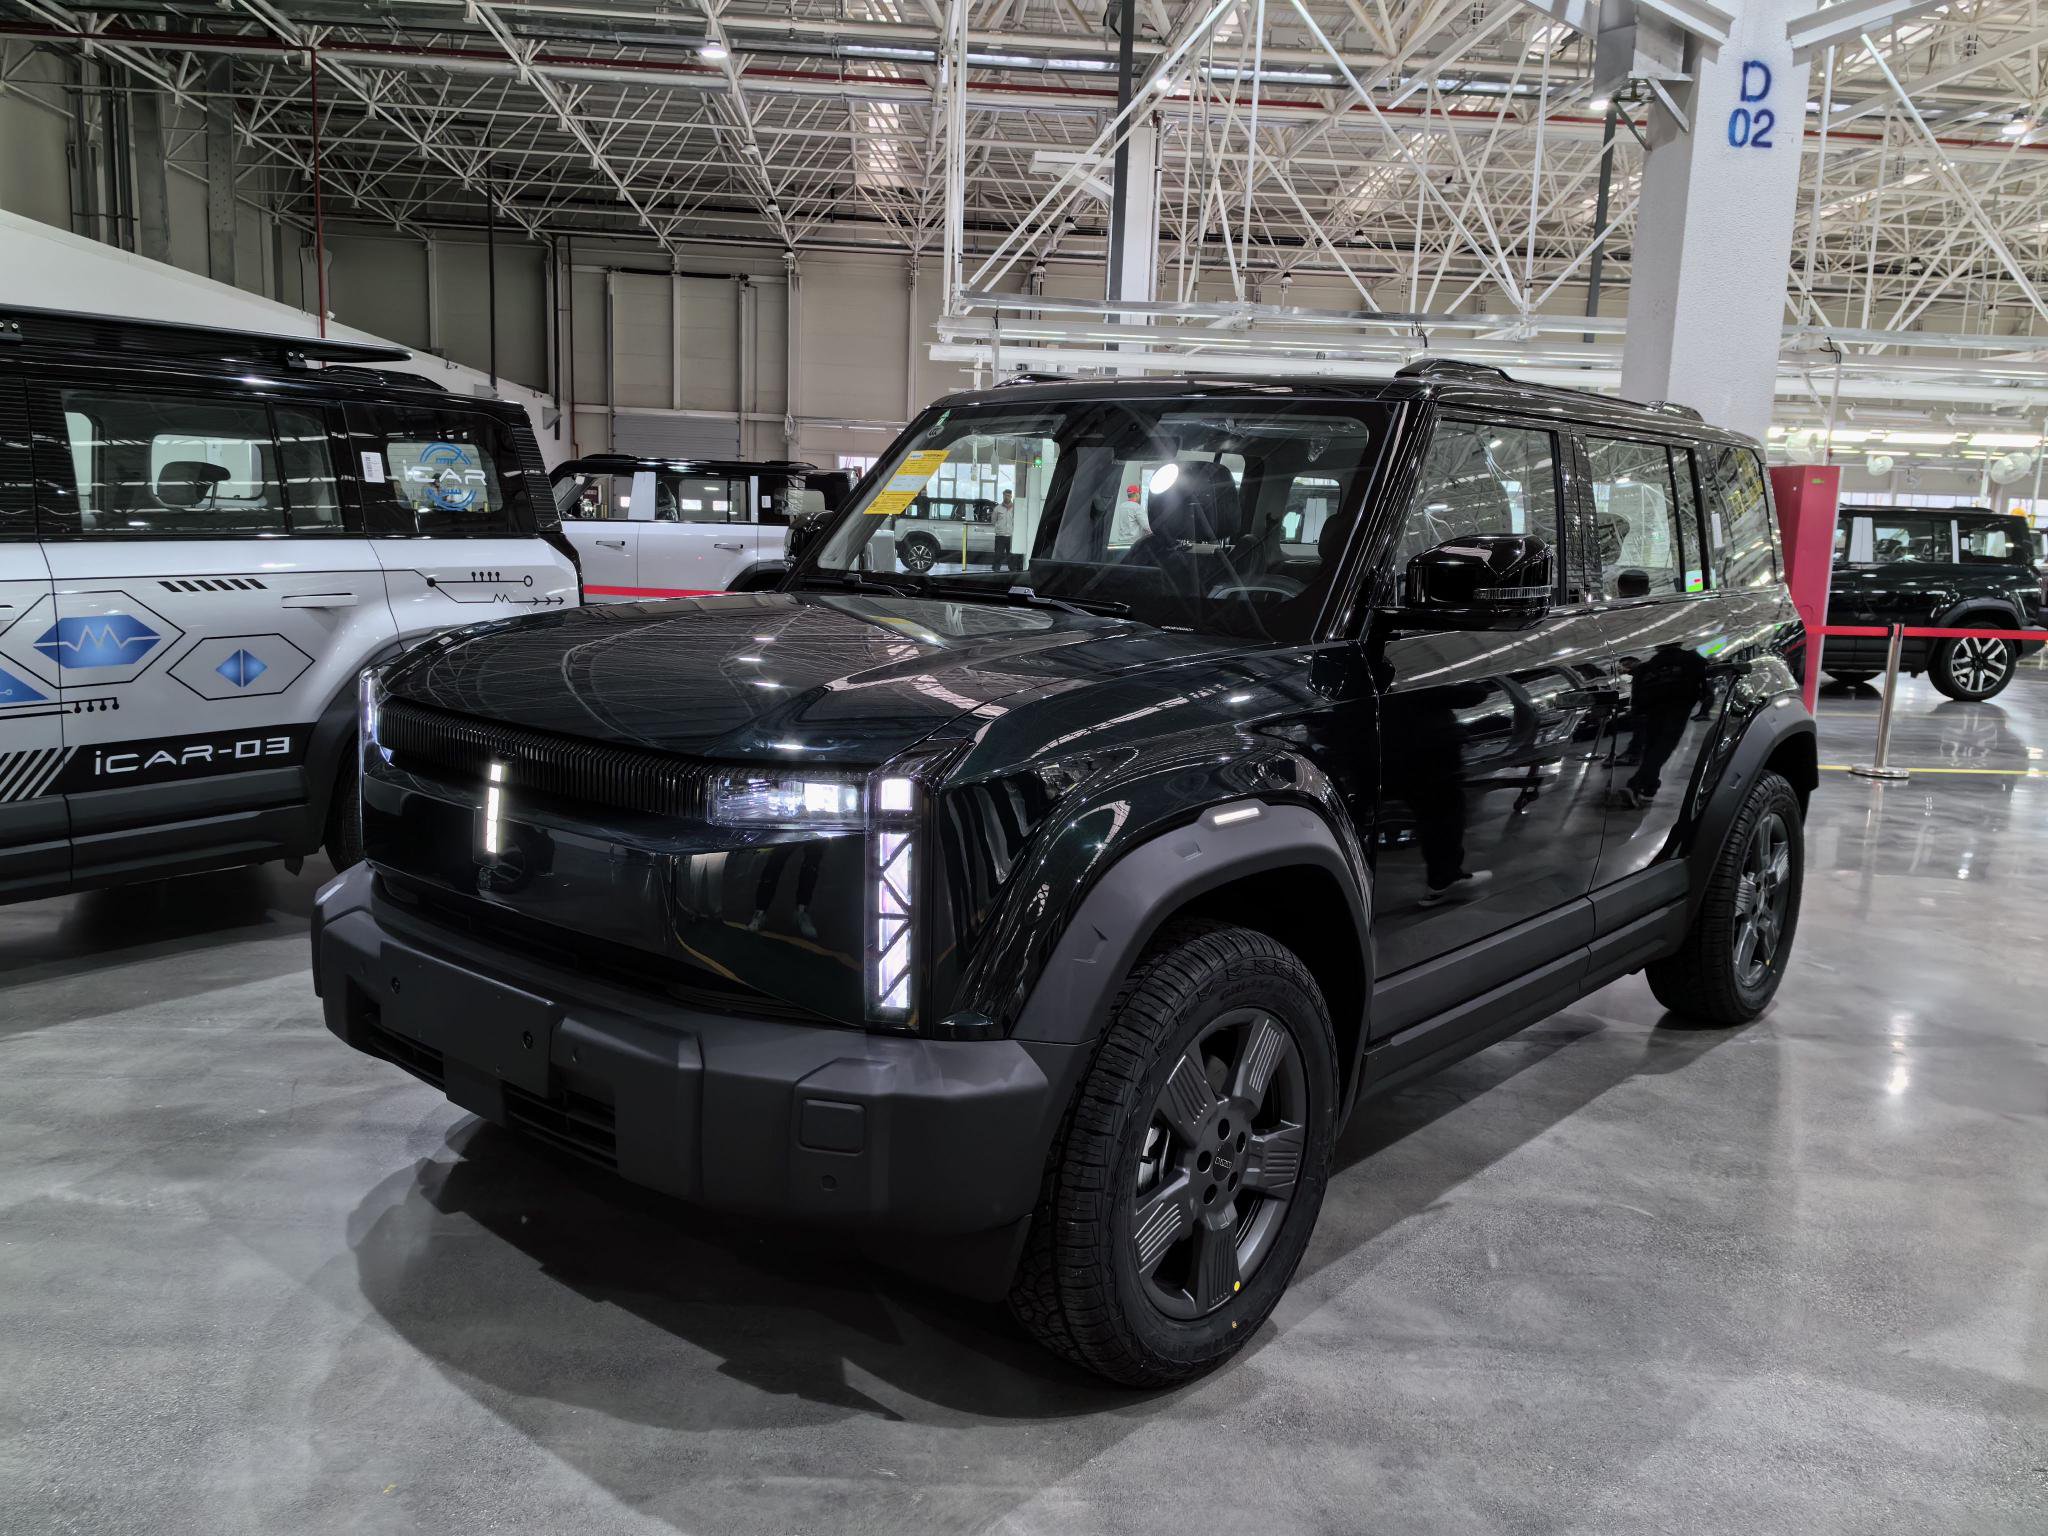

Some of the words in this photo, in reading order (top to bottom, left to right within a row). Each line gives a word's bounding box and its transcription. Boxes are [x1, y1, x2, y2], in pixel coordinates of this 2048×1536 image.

[1740, 60, 1772, 102] D
[1728, 108, 1775, 148] 02
[402, 459, 488, 486] iCAR
[95, 736, 291, 776] iCAR-03
